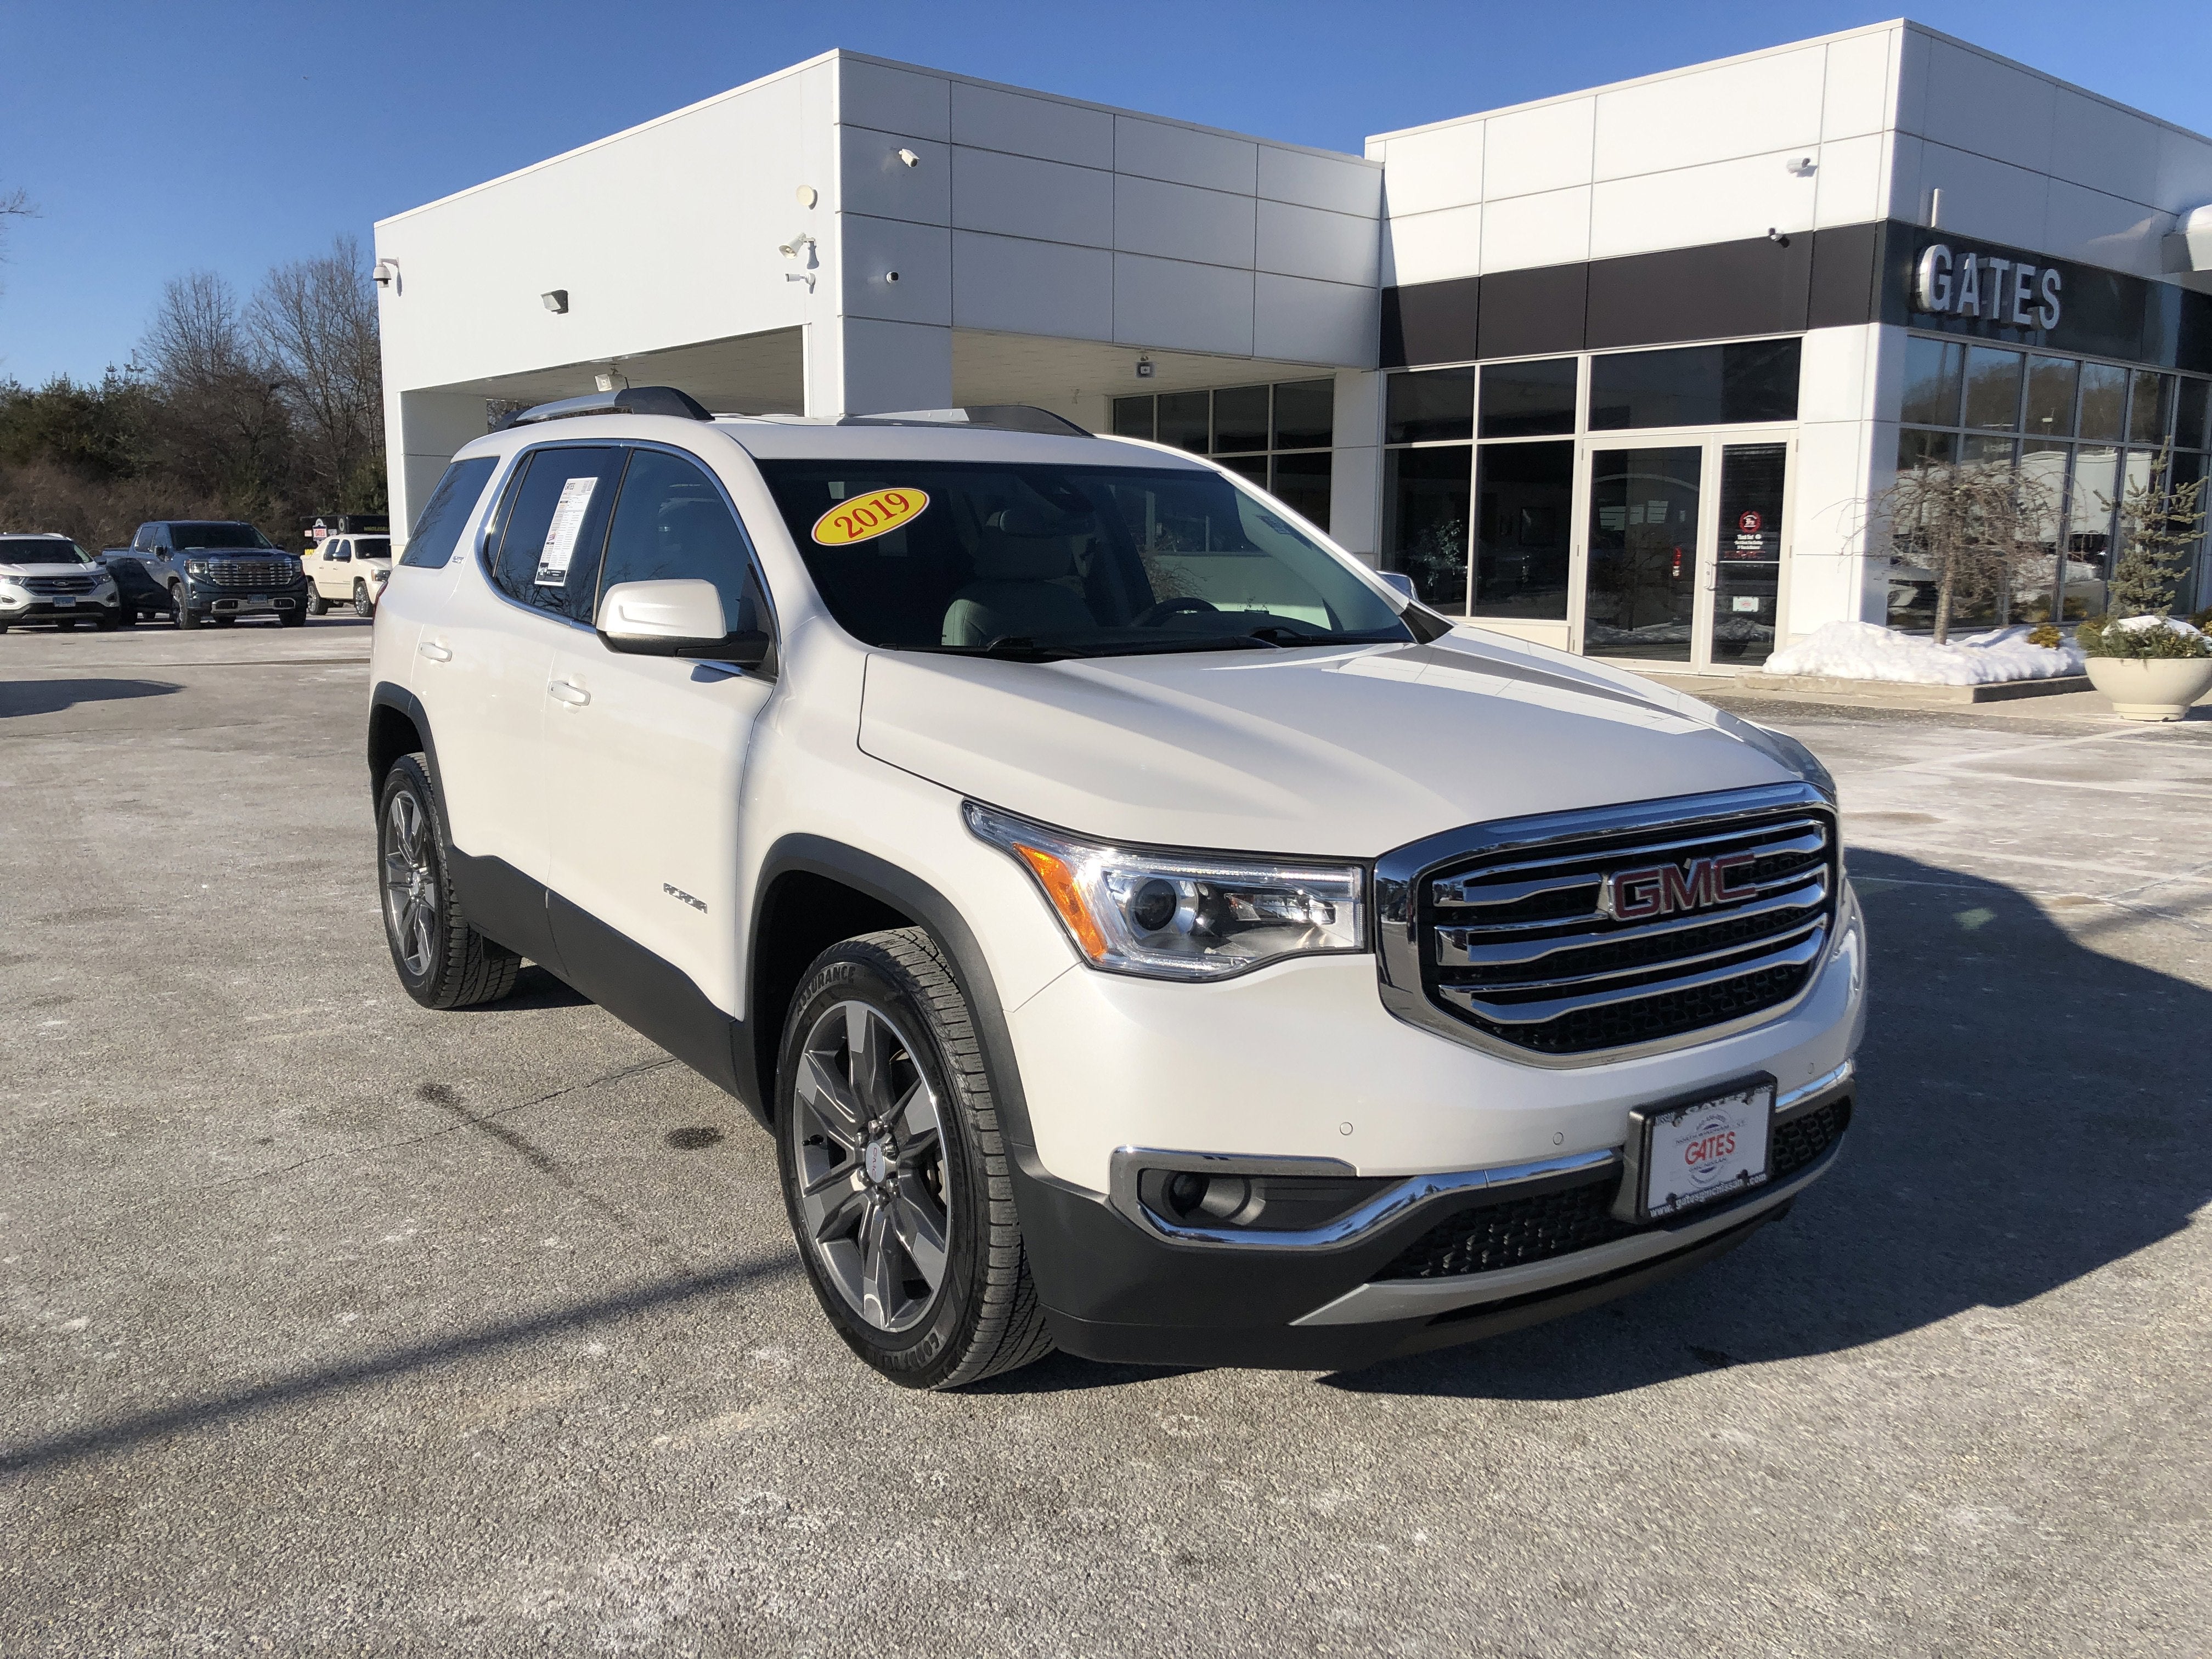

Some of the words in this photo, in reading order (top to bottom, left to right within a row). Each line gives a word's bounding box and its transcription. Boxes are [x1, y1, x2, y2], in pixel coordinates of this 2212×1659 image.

[1919, 244, 2061, 329] GATES
[834, 493, 910, 539] 2019
[1608, 853, 1757, 922] GMC
[797, 964, 856, 1017] ASSURANCE
[1685, 1131, 1736, 1165] GATES
